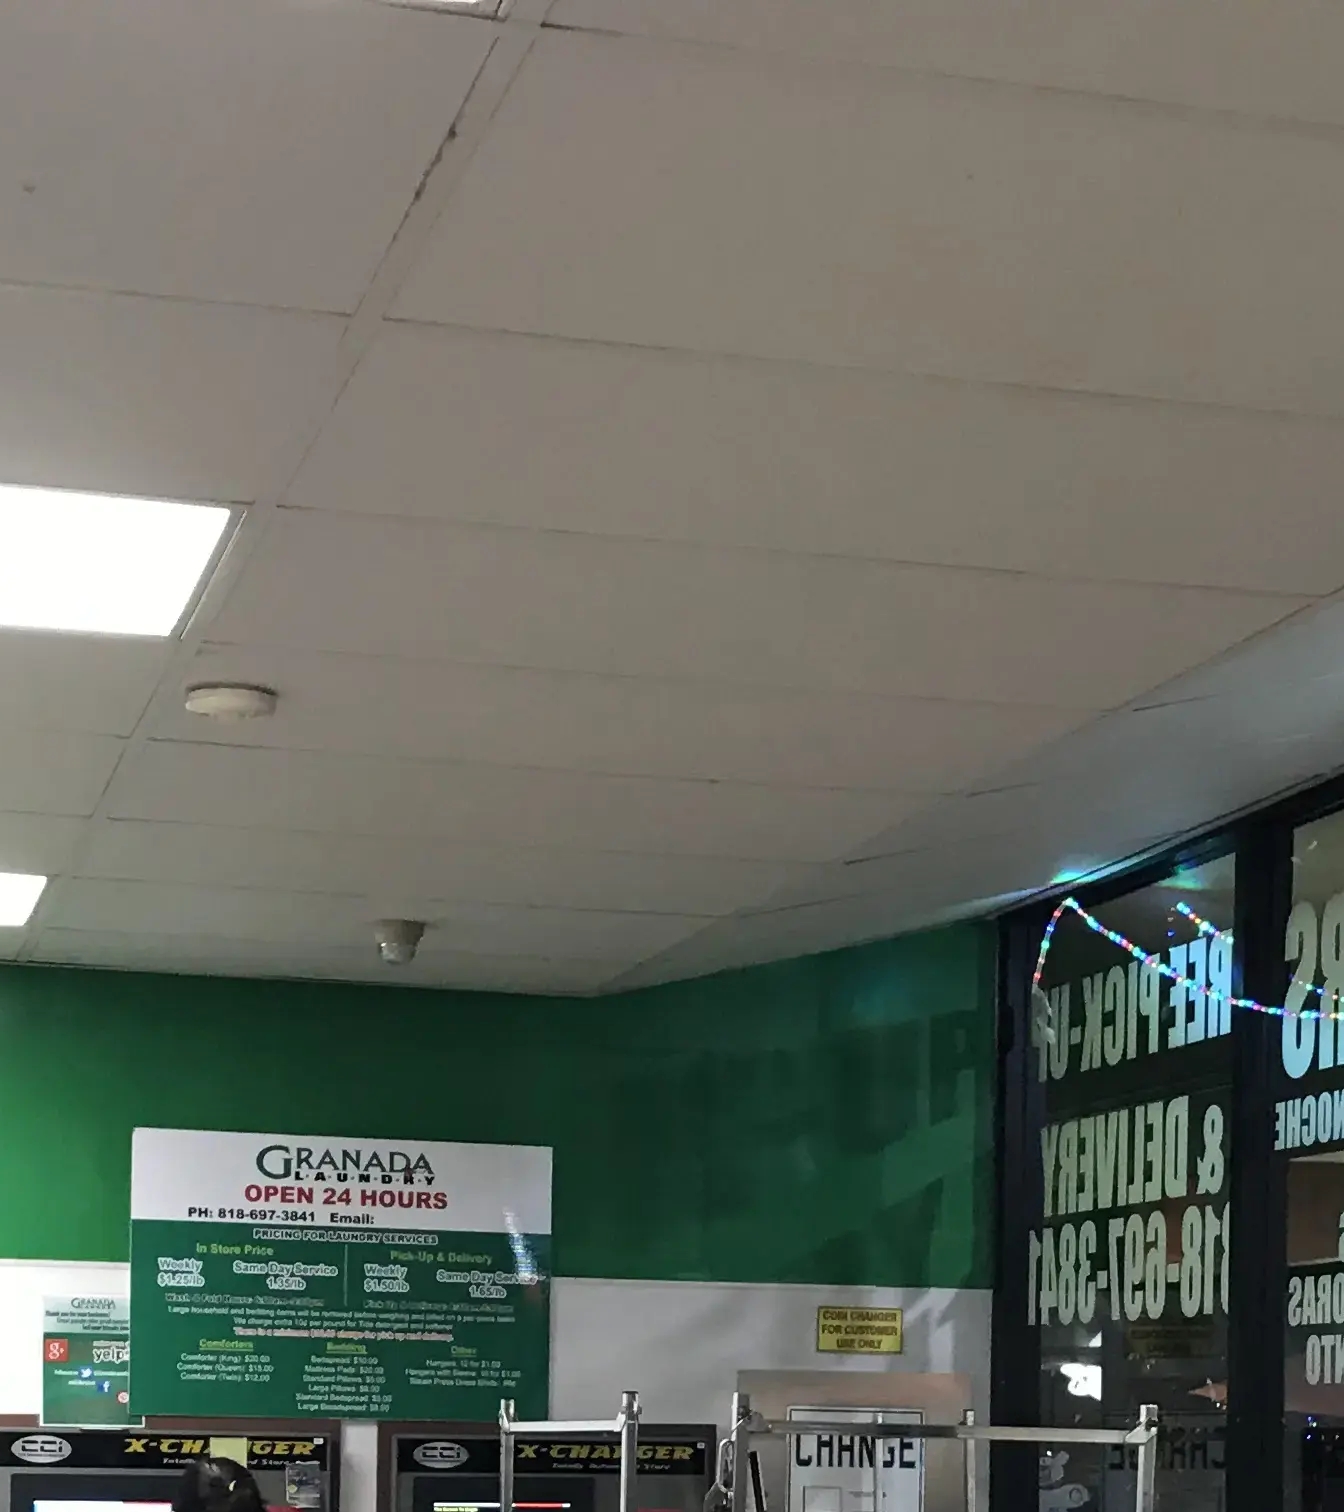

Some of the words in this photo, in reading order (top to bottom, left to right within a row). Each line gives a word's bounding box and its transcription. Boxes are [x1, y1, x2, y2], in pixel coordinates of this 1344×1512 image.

[256, 1145, 434, 1181] GRANADA
[244, 1184, 313, 1204] OPEN
[322, 1187, 352, 1206] 24
[360, 1190, 448, 1210] HOURS
[188, 1207, 214, 1219] PH:
[217, 1208, 316, 1223] 818-697-3841
[330, 1212, 375, 1225] Email:
[254, 1228, 301, 1242] PRICING
[303, 1231, 327, 1243] FOR
[329, 1231, 381, 1244] LAUNDRY
[383, 1233, 438, 1246] SERVICES
[196, 1242, 207, 1254] In
[210, 1244, 242, 1255] Store
[244, 1245, 274, 1256] Price
[158, 1258, 203, 1273] Weekly
[233, 1261, 267, 1274] Same
[268, 1262, 292, 1277] Day
[293, 1263, 338, 1276] Service
[390, 1251, 434, 1263] Pick-Up
[437, 1252, 445, 1262] &
[448, 1253, 493, 1266] Delivery
[157, 1273, 205, 1287] $1.25/lb
[267, 1277, 306, 1290] 1.35/lb
[364, 1264, 407, 1279] Weekly
[436, 1269, 469, 1283] Same
[470, 1270, 494, 1286] Day
[364, 1279, 410, 1292] $1.50/lb
[850, 1311, 897, 1322] CHANGER
[821, 1325, 842, 1335] FOR
[844, 1326, 898, 1336] CUSTOMER
[93, 1347, 124, 1362] yelp
[123, 1438, 316, 1456] X-CHGER
[516, 1443, 695, 1461] X-CHAGER
